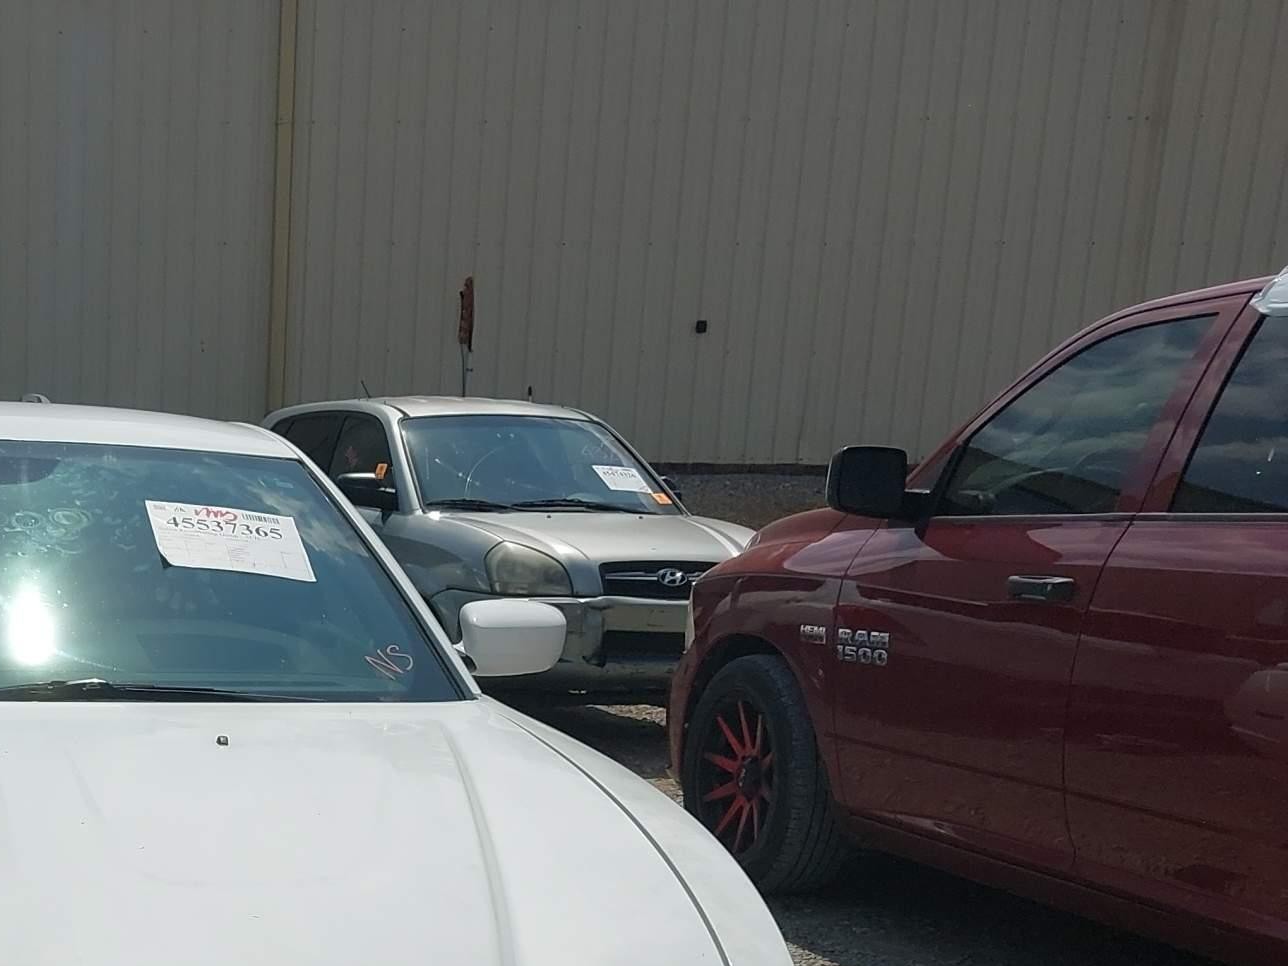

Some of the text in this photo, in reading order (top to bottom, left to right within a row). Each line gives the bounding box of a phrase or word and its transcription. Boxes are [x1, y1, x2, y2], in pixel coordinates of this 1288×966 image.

[167, 516, 283, 540] 45537365
[799, 624, 826, 634] HEMI
[837, 628, 890, 649] RAM
[364, 644, 414, 680] NS
[836, 645, 888, 666] 1500
